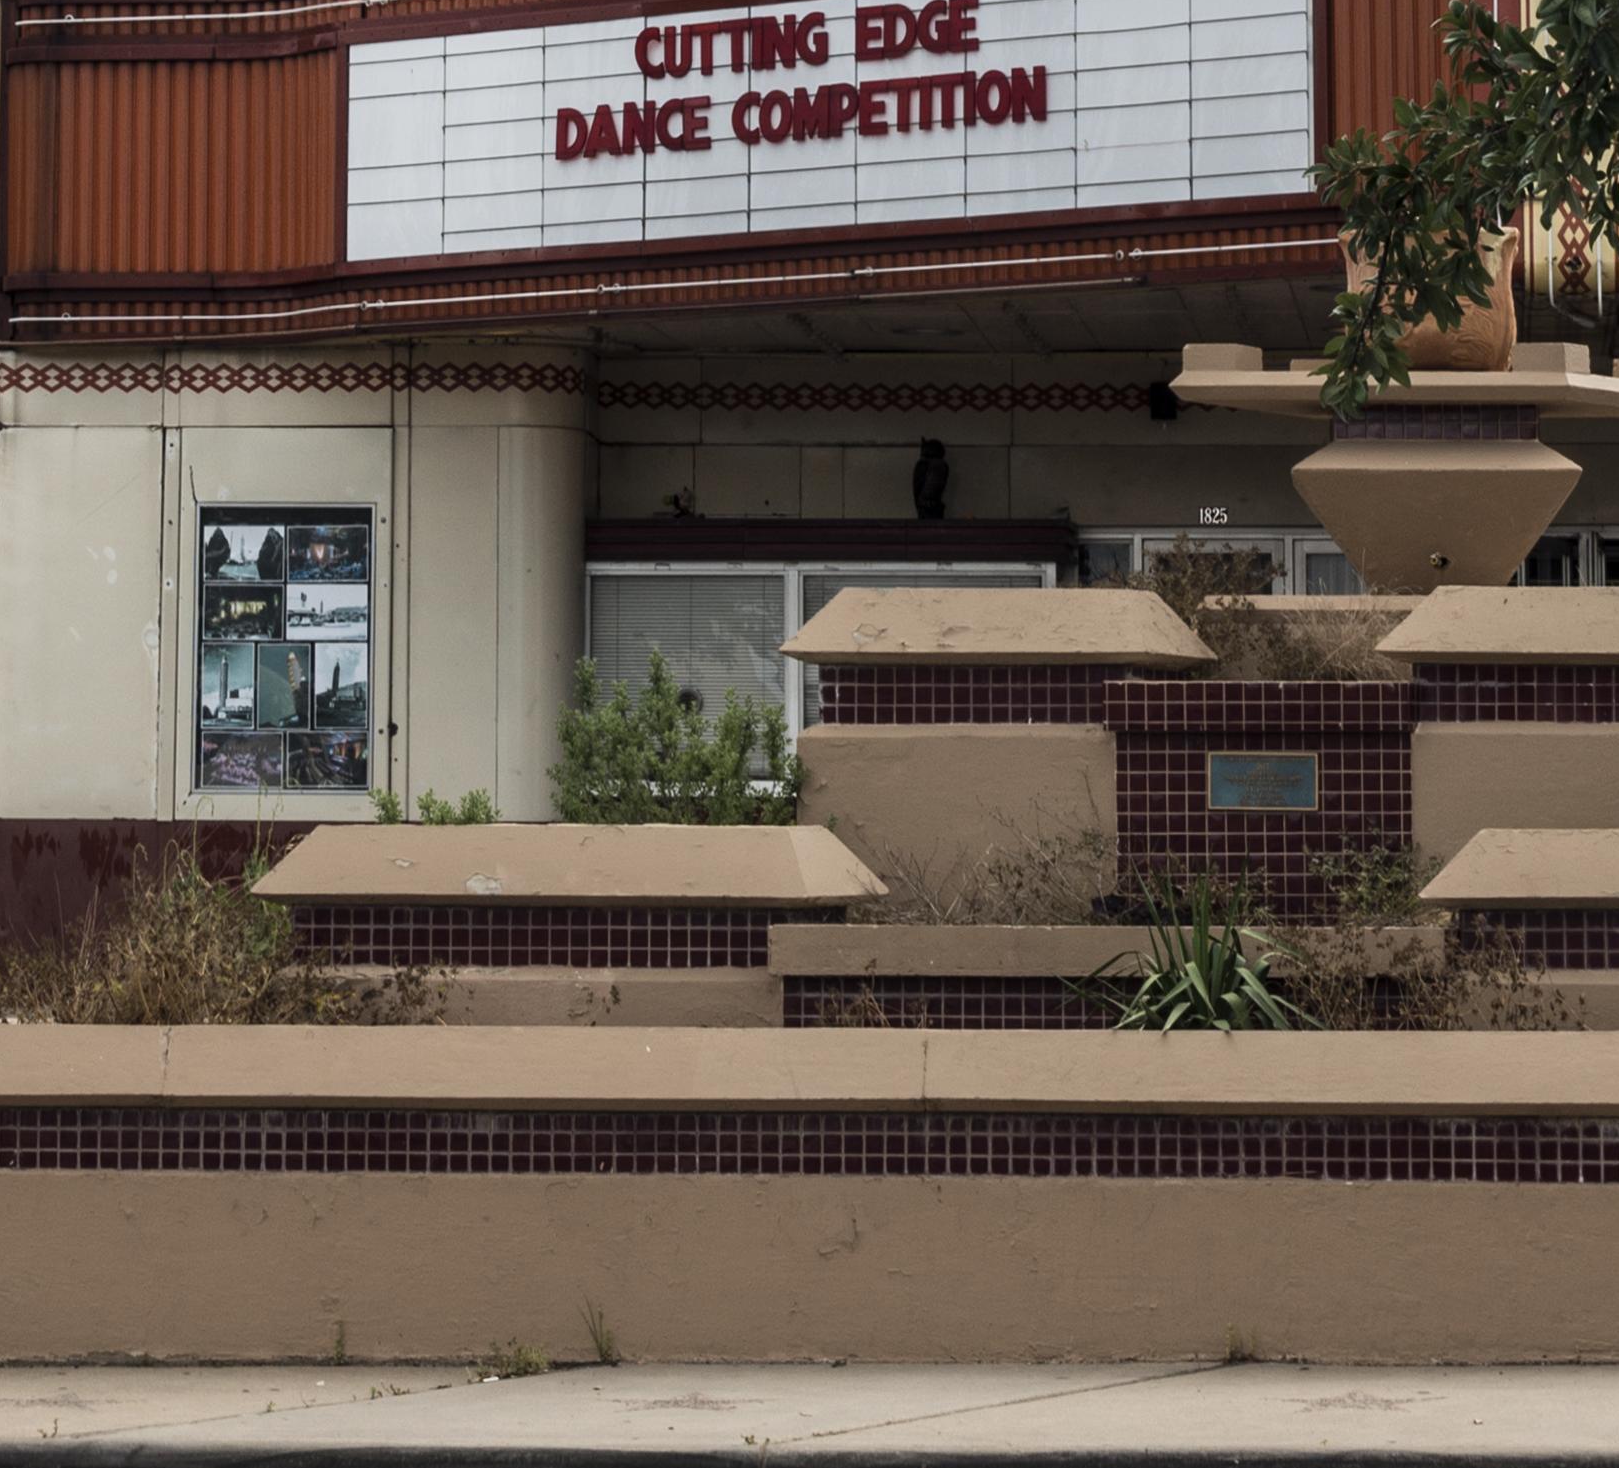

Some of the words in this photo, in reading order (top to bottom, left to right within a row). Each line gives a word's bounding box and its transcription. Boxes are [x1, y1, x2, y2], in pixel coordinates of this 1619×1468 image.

[634, 11, 829, 80] CUTTING
[555, 95, 712, 161] DANCE
[731, 65, 1047, 146] COMPETITION
[1198, 506, 1228, 525] 1825
